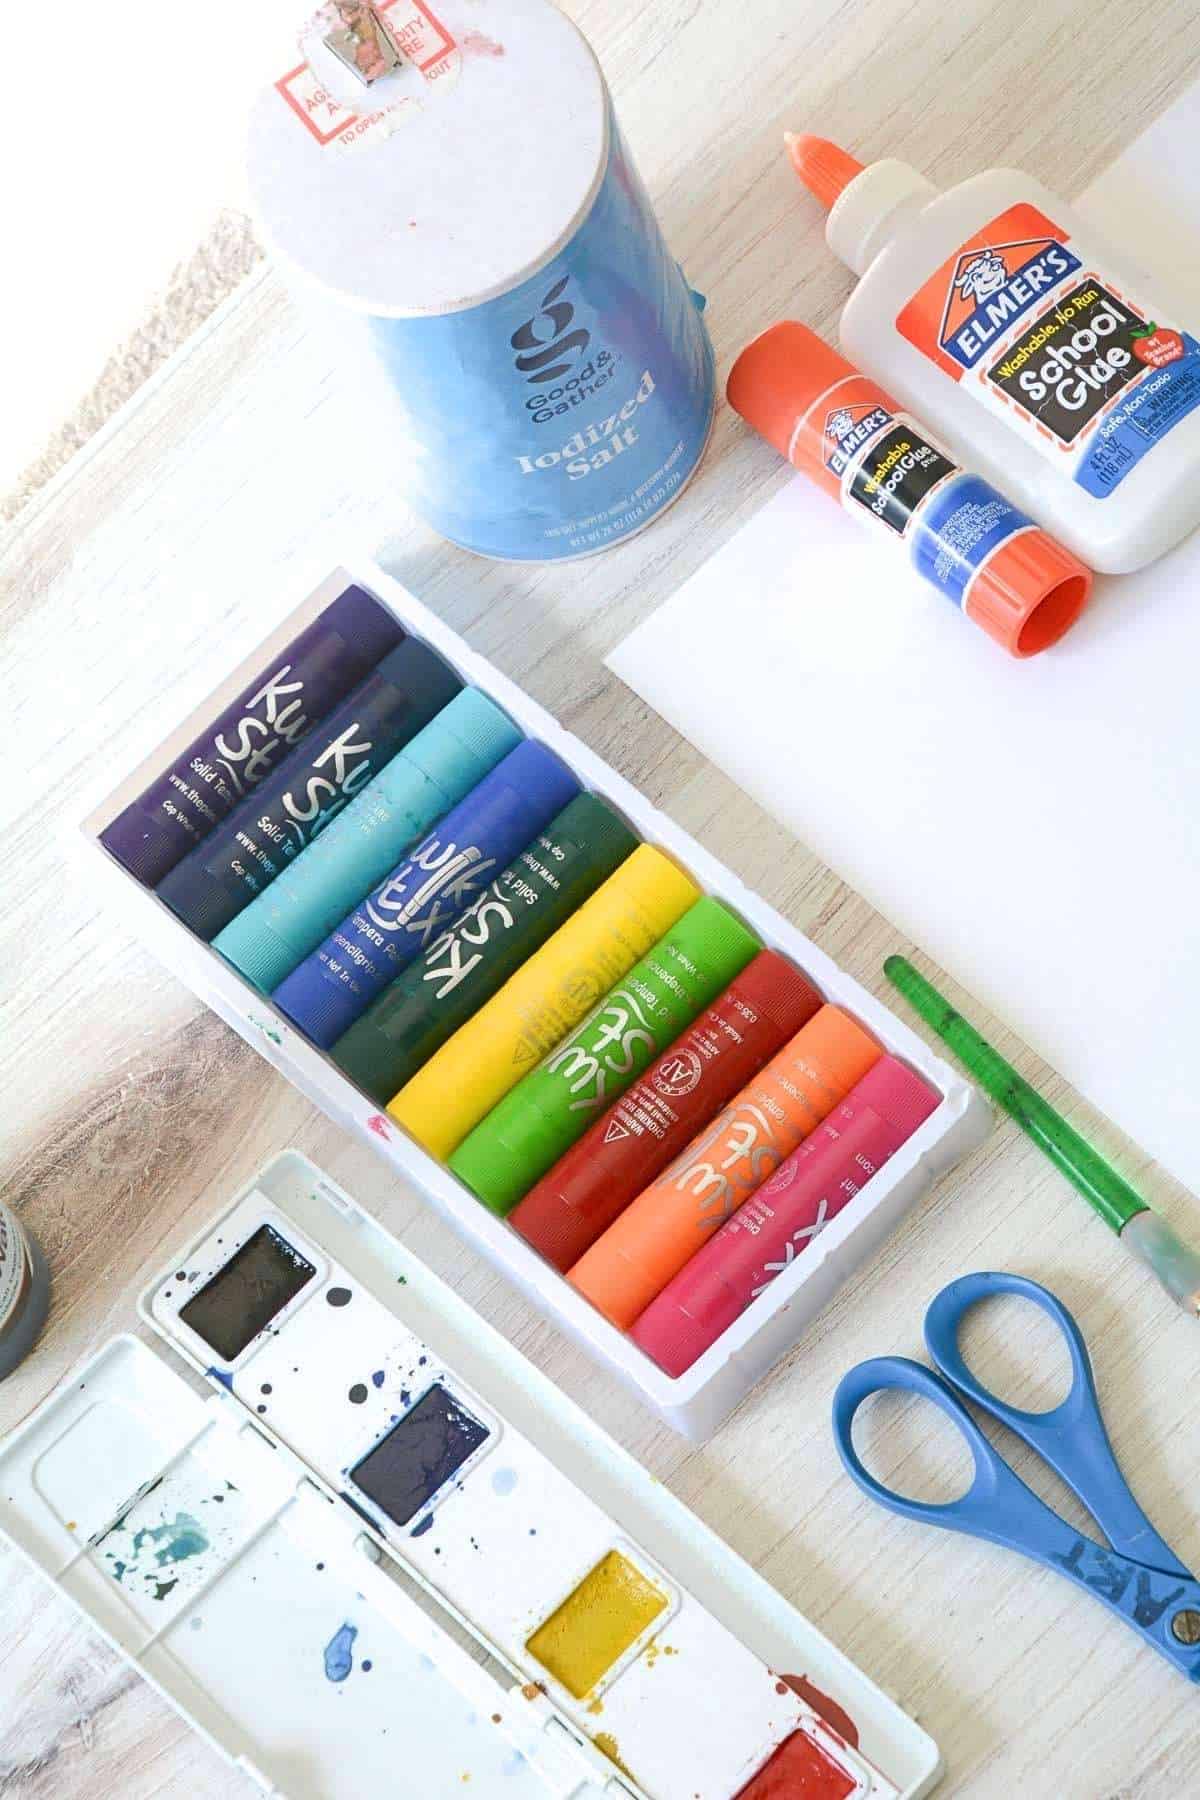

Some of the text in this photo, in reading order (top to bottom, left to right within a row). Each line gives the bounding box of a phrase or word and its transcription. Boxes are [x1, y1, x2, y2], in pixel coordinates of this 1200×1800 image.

[956, 249, 1069, 358] ELMER'S
[1056, 306, 1075, 327] No
[1072, 288, 1099, 313] Run
[1019, 299, 1127, 401] School
[526, 360, 597, 410] Good
[531, 362, 616, 424] Gather
[1056, 347, 1132, 411] Glue
[1122, 372, 1172, 415] Non-Toxic
[513, 369, 656, 475] Iodized
[565, 424, 640, 481] Salt
[863, 441, 911, 494] Washable
[900, 446, 932, 470] Glue
[190, 757, 217, 782] Solid
[162, 800, 178, 817] Cap
[257, 816, 286, 843] Solid
[231, 860, 245, 876] Cap
[551, 846, 566, 861] Cap
[511, 879, 538, 905] Solid
[352, 912, 385, 947] empera
[327, 958, 341, 974] Not
[659, 1059, 693, 1083] AP
